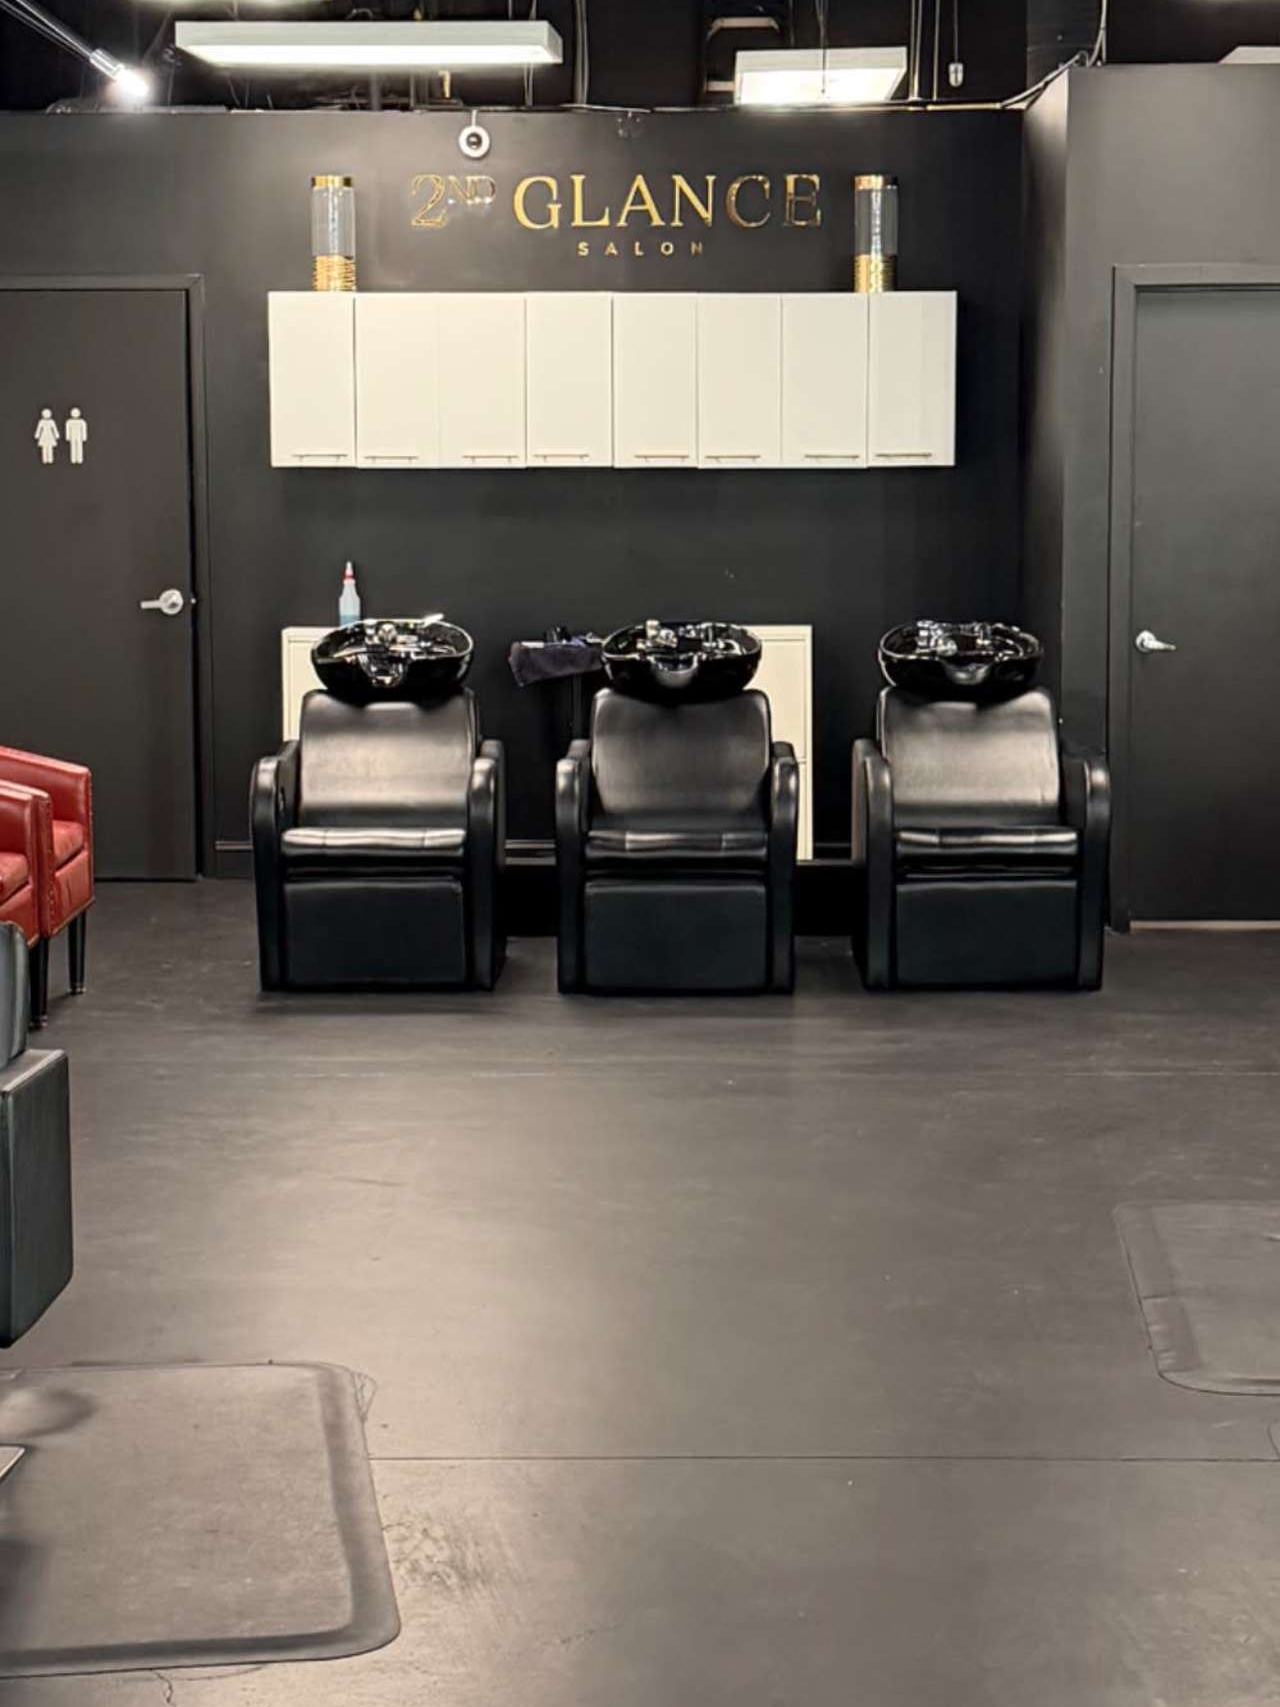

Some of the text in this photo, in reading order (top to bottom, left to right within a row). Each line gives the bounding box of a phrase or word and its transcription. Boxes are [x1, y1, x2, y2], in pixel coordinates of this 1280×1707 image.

[410, 173, 821, 230] 2ND GLANCE
[578, 241, 703, 256] SALON
